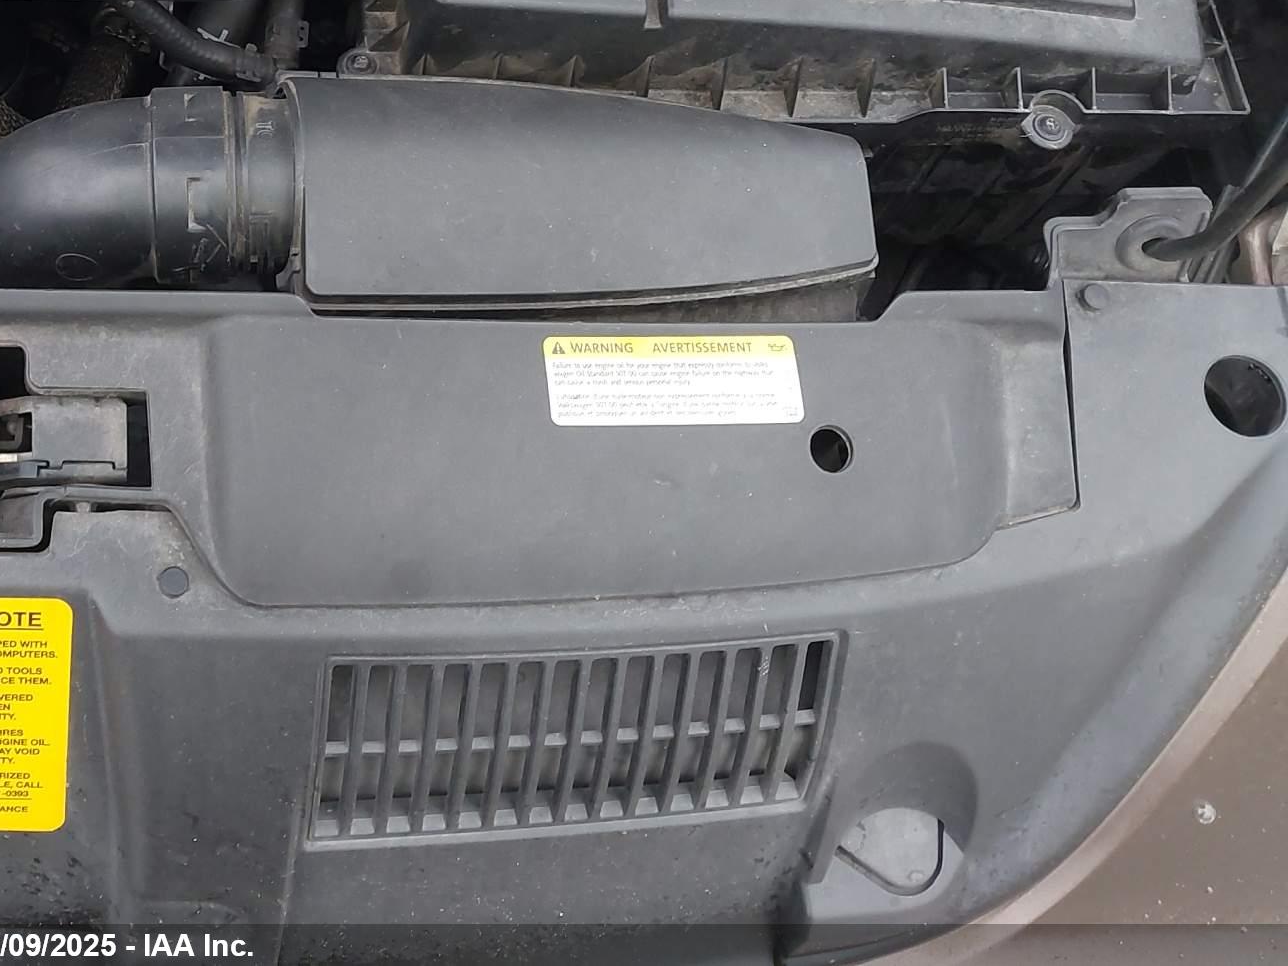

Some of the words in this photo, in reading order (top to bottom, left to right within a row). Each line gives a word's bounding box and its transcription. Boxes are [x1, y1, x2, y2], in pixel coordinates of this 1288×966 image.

[570, 342, 634, 354] WARNING
[652, 342, 752, 353] AVERTISSEMENT
[19, 640, 48, 649] WITH
[6, 666, 43, 676] TOOLS
[17, 676, 53, 685] THEM.
[30, 738, 50, 747] OIL.
[14, 747, 41, 756] VOID
[15, 781, 44, 789] CALL
